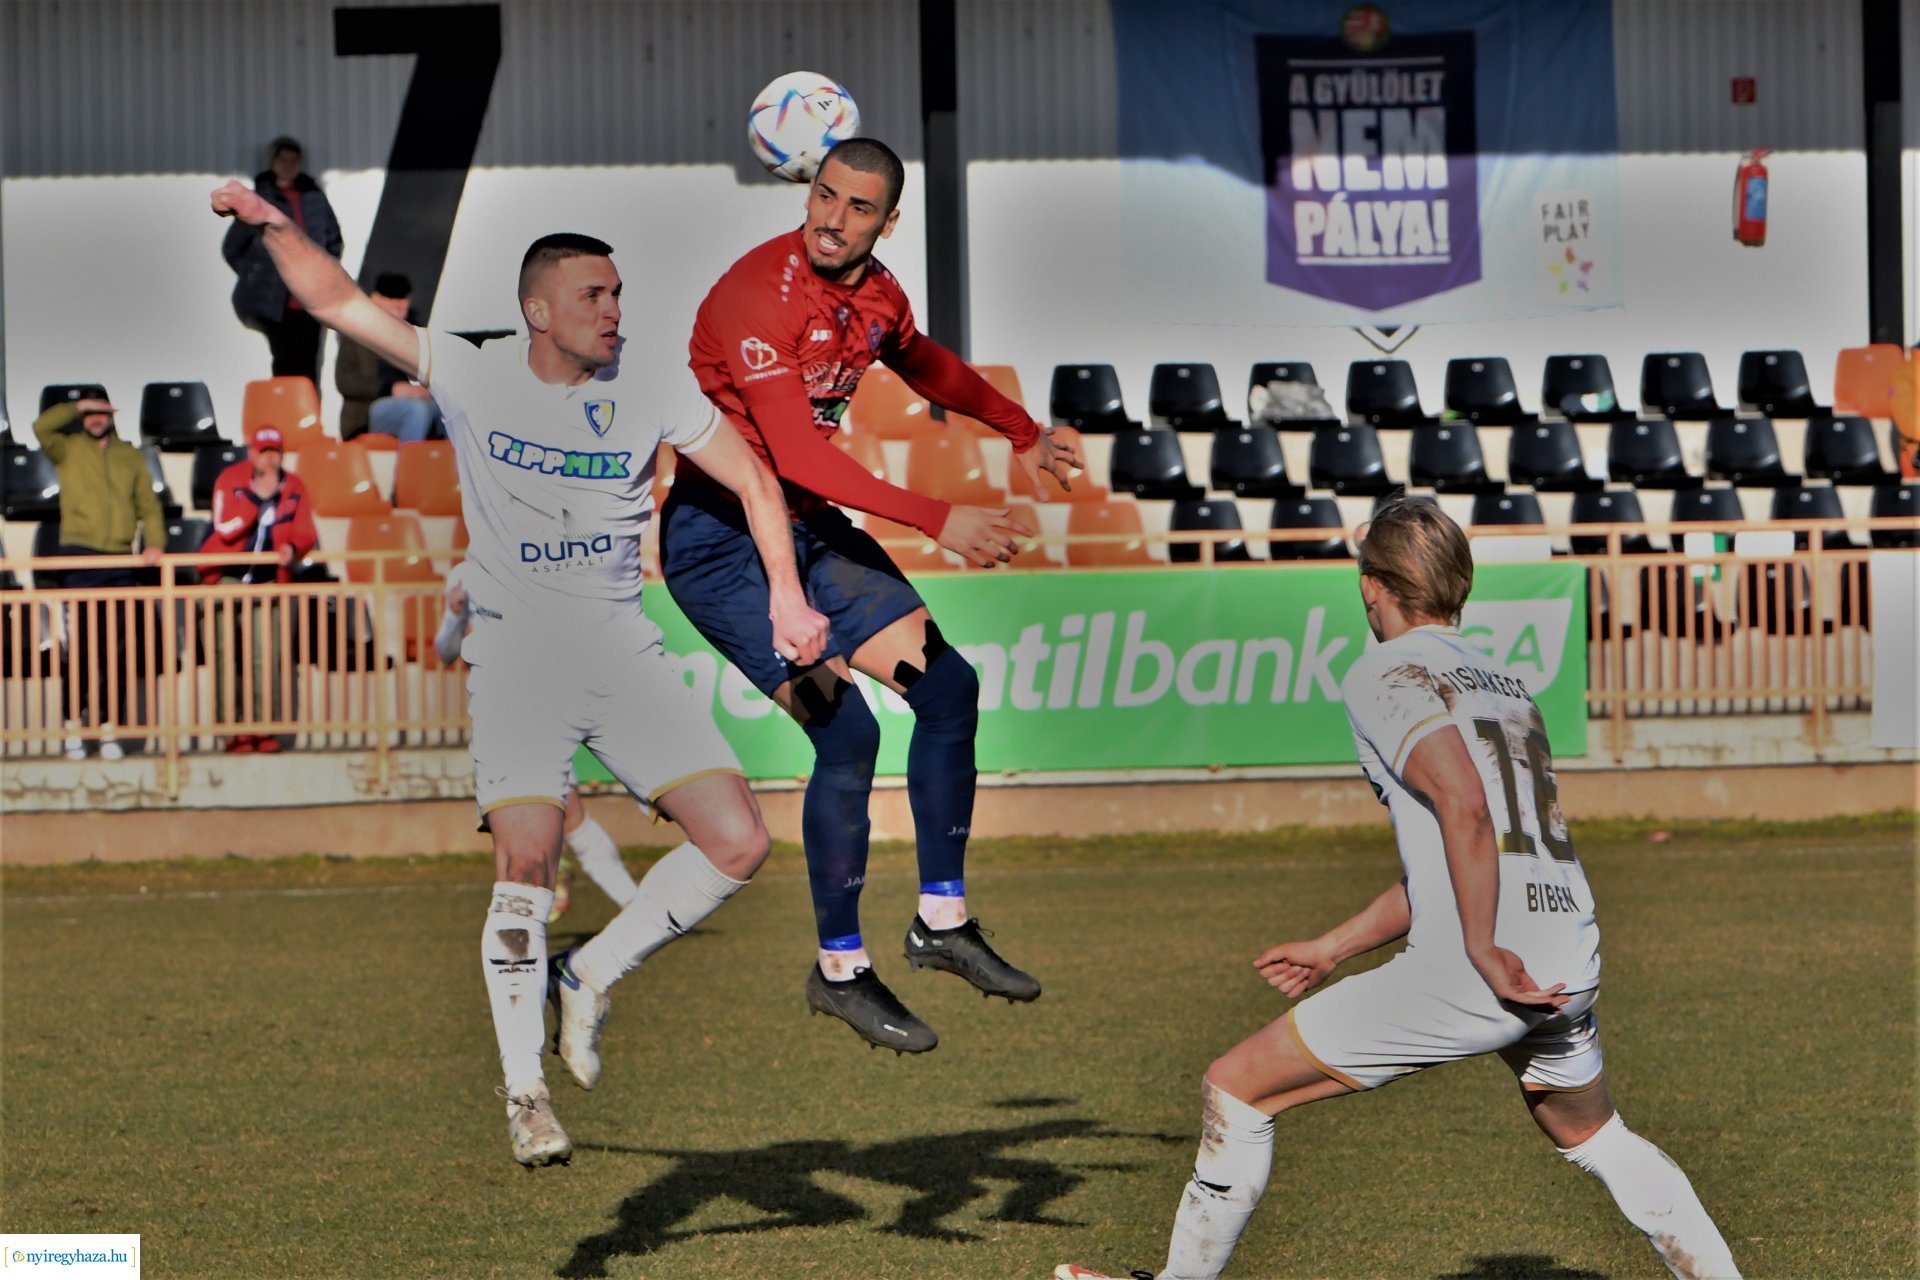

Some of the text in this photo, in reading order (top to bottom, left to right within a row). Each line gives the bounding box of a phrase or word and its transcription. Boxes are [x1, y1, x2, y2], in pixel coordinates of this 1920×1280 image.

[1288, 74, 1309, 105] A
[1290, 107, 1449, 192] NEM
[1294, 192, 1449, 256] PÁLYA!
[1541, 200, 1590, 220] FAIR
[1543, 222, 1590, 243] PLAY
[531, 556, 604, 573] ASZFALT
[1526, 882, 1580, 912] BIBEN
